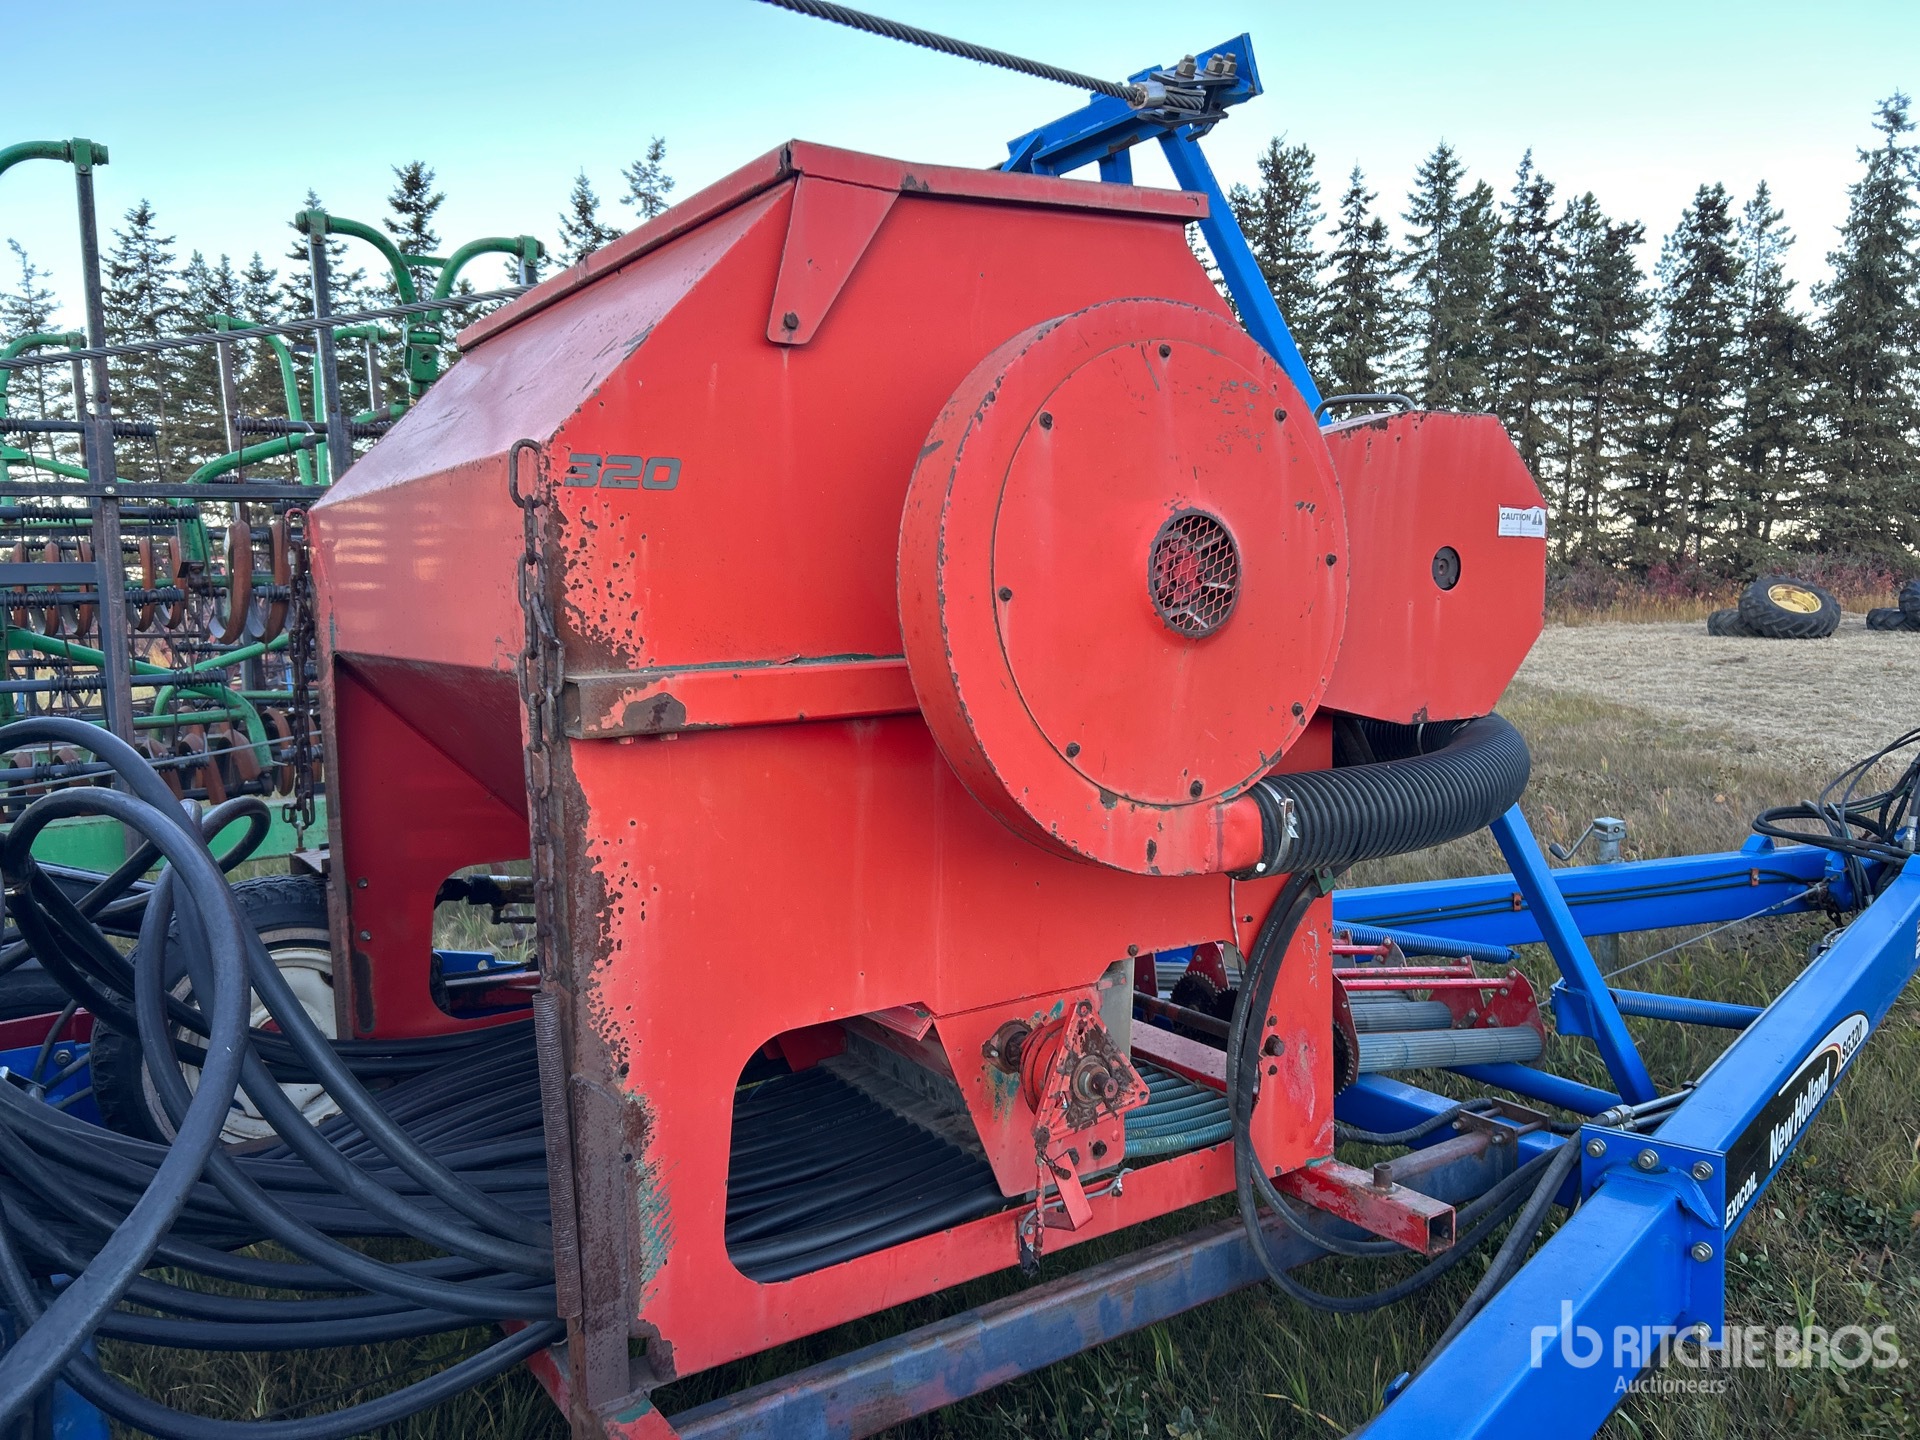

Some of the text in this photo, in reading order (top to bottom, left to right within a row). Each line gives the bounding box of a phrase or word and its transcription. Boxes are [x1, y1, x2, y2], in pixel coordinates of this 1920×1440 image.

[563, 453, 682, 490] 320
[1501, 512, 1531, 521] CAUTION
[1769, 1056, 1830, 1169] New Holland
[1723, 1171, 1758, 1231] EXICOIL
